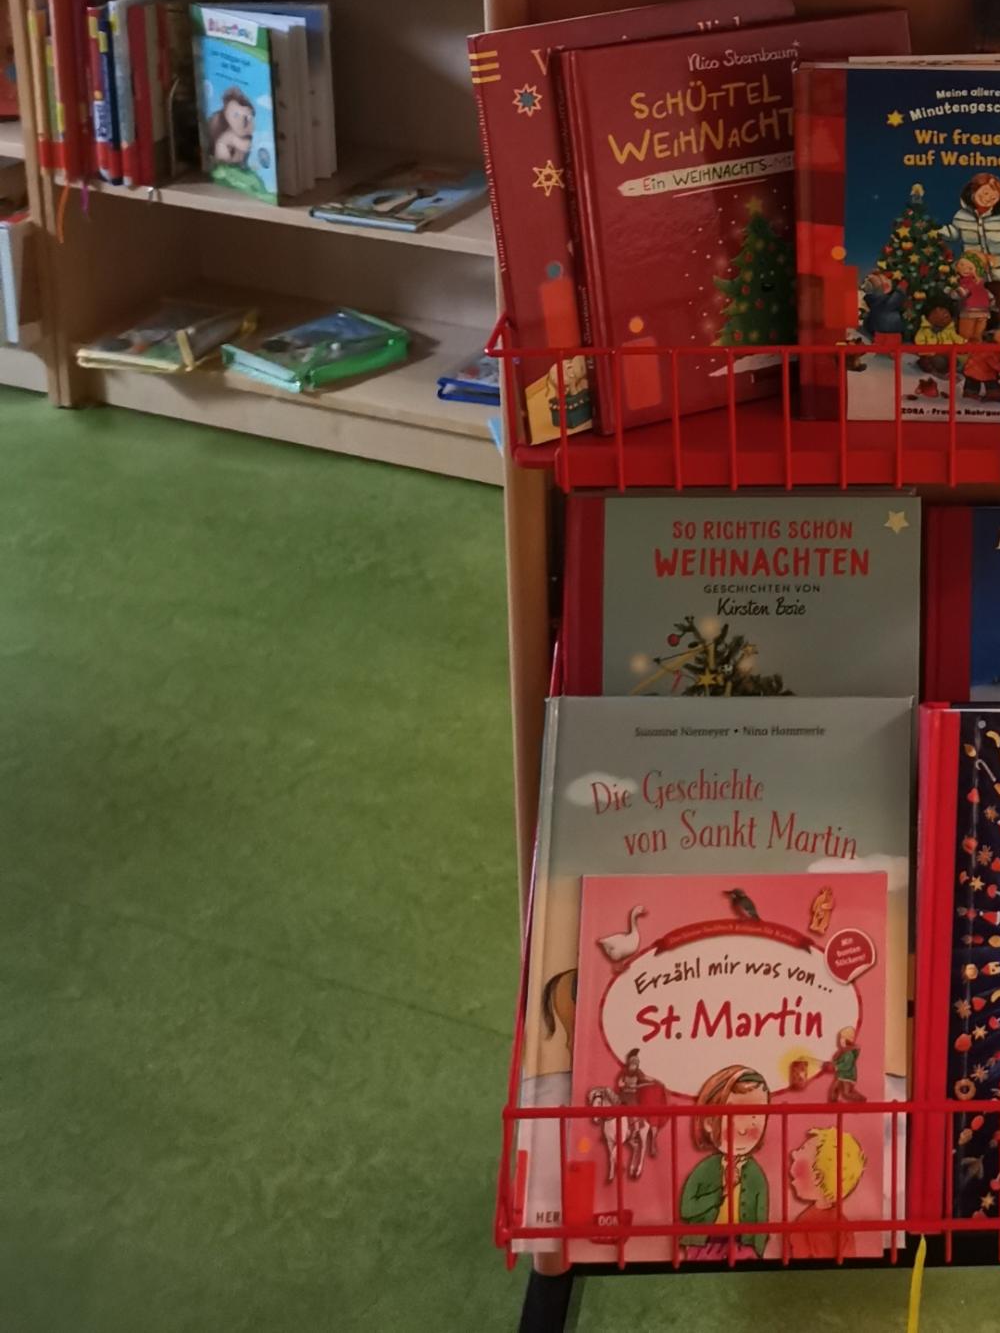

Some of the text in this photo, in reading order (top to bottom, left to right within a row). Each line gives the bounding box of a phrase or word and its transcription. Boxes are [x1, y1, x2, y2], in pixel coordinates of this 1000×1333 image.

[688, 52, 720, 72] Nico
[630, 74, 782, 120] SCHÜTTEL
[936, 88, 968, 100] Meine
[914, 129, 948, 145] Wir
[903, 150, 936, 166] auf
[671, 520, 697, 540] SO
[703, 520, 781, 541] RICHTIG
[654, 547, 871, 578] WEIHNACHTEN
[703, 583, 821, 594] GESCHICHTEN VON
[717, 597, 770, 616] Kirsten
[591, 768, 764, 815] Die Geschichte
[624, 809, 858, 860] von Sankt Martin
[633, 957, 701, 995] Erzähl
[707, 954, 741, 978] mir
[745, 961, 781, 979] was
[635, 995, 823, 1043] St. Martin
